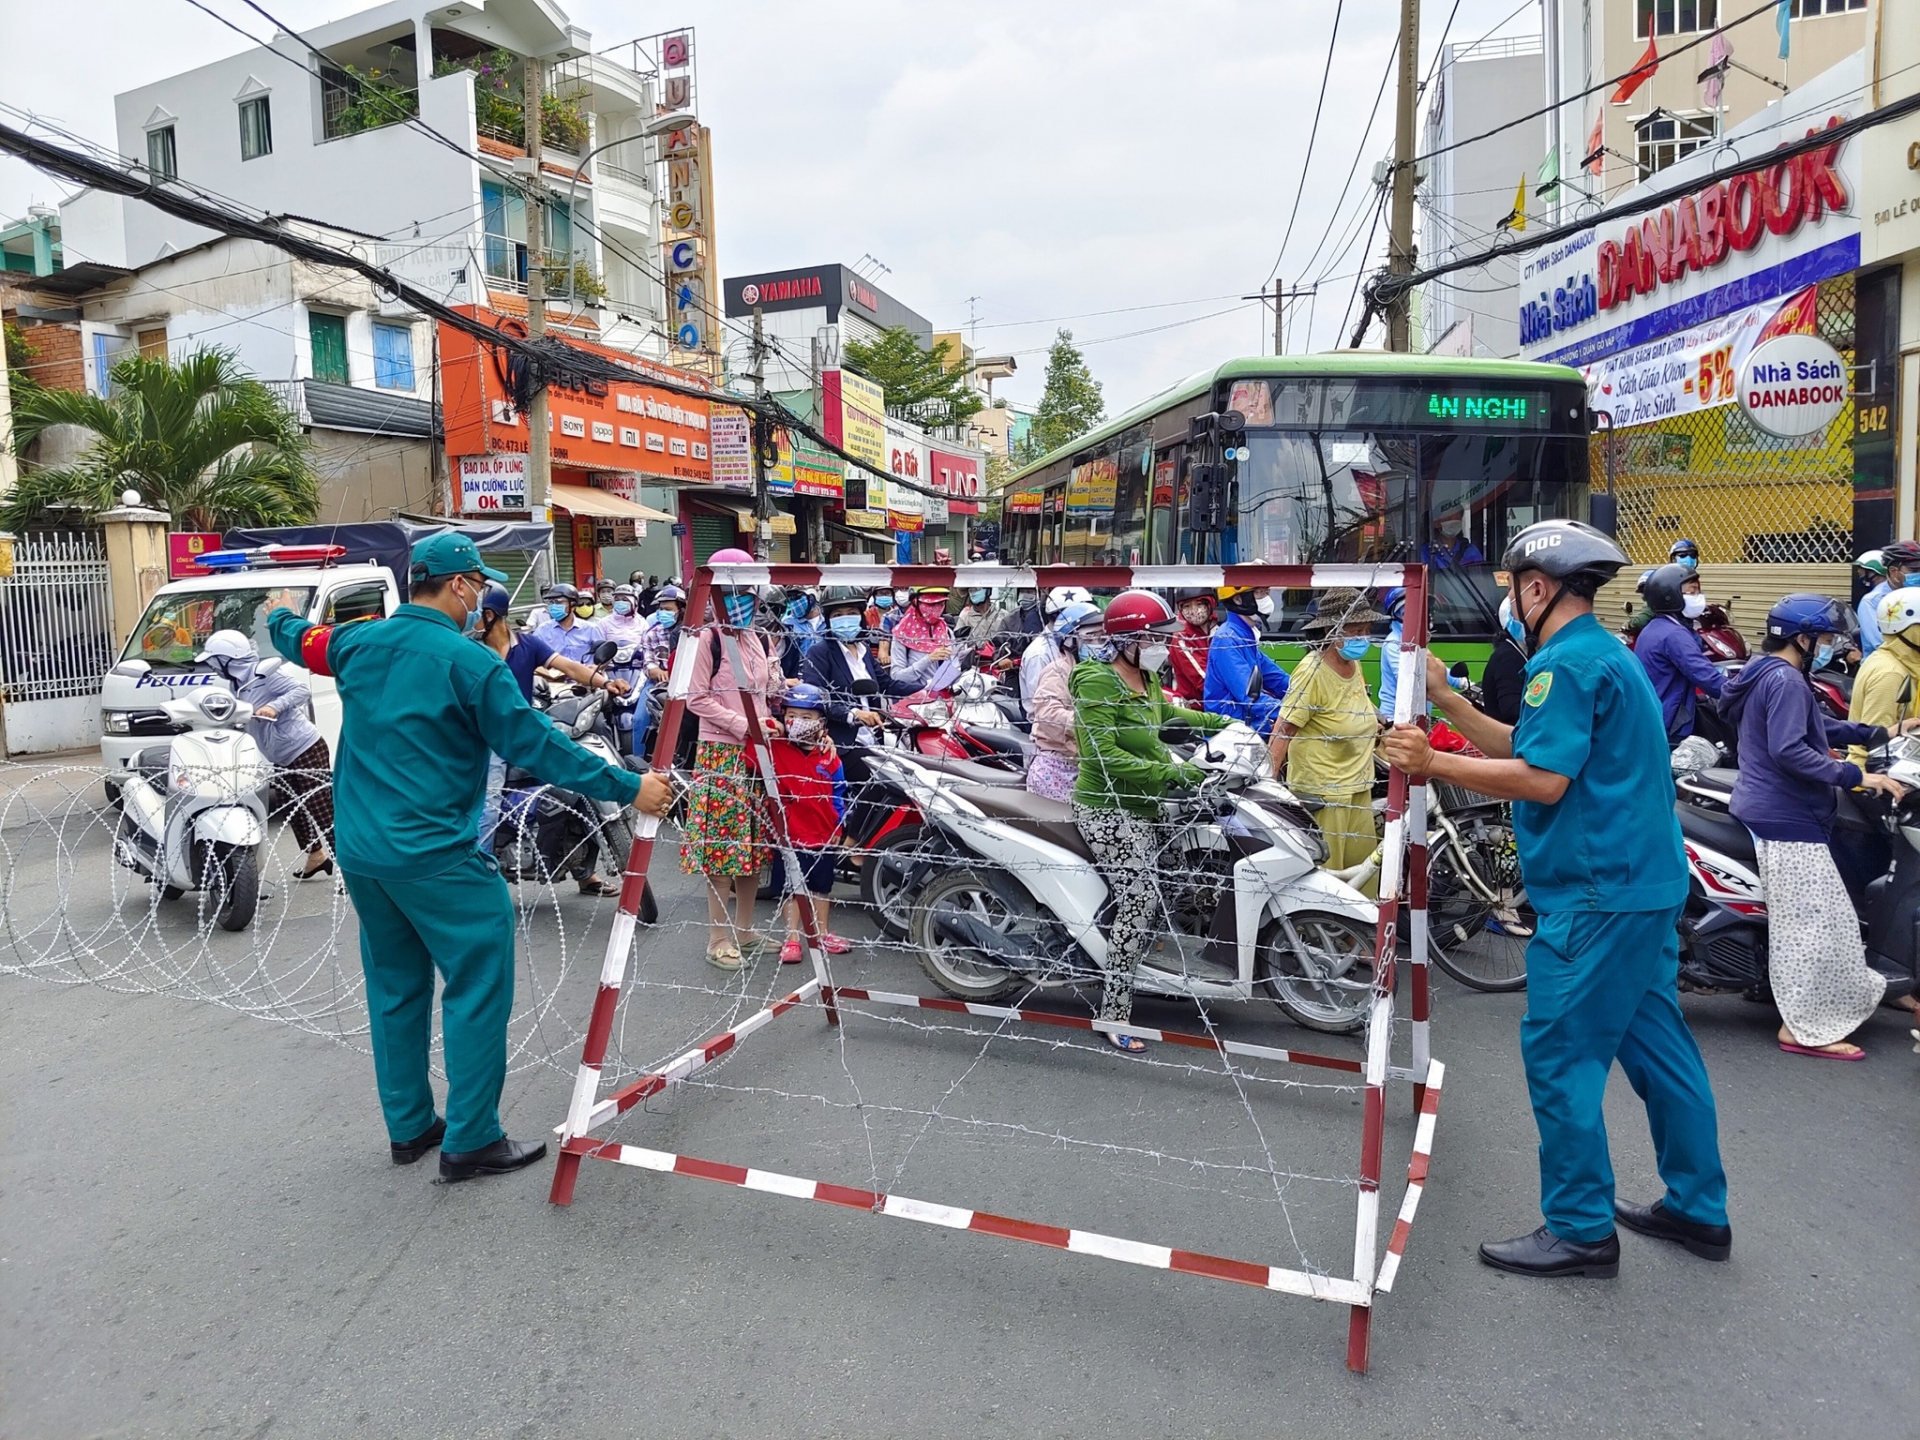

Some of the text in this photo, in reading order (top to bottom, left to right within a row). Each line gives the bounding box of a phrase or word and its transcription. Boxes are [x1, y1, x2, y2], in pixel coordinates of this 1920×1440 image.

[1597, 115, 1848, 309] DANABOOK
[1894, 198, 1907, 218] LÊ
[1524, 229, 1596, 280] CTY TNHH Sách DANABOOK
[760, 276, 822, 302] YAMAHA
[857, 284, 877, 313] YAMAHA
[1520, 274, 1598, 346] Nhà Sách
[1616, 373, 1637, 398] Sách
[1661, 362, 1687, 385] Khoa
[1753, 359, 1841, 384] Nhà Sách
[1466, 397, 1526, 419] NGHI
[1749, 385, 1843, 409] DANABOOK
[1613, 404, 1631, 428] Tập
[1653, 392, 1677, 417] Sinh
[1860, 405, 1887, 433] 542
[563, 420, 584, 432] SONY
[594, 425, 613, 437] oppo
[492, 437, 505, 449] ĐC:
[506, 440, 519, 452] 473
[520, 440, 529, 453] LÊ
[464, 457, 524, 476] BAO DA, ỐP LƯNG
[891, 448, 903, 476] Cà
[904, 447, 919, 477] Rốt
[464, 478, 524, 494] DÁN CƯỜNG LỰC
[940, 467, 979, 498] JUNO
[478, 495, 499, 509] Ok
[135, 674, 216, 689] POLICE
[957, 820, 1005, 842] VISION
[1241, 868, 1268, 877] HONDA
